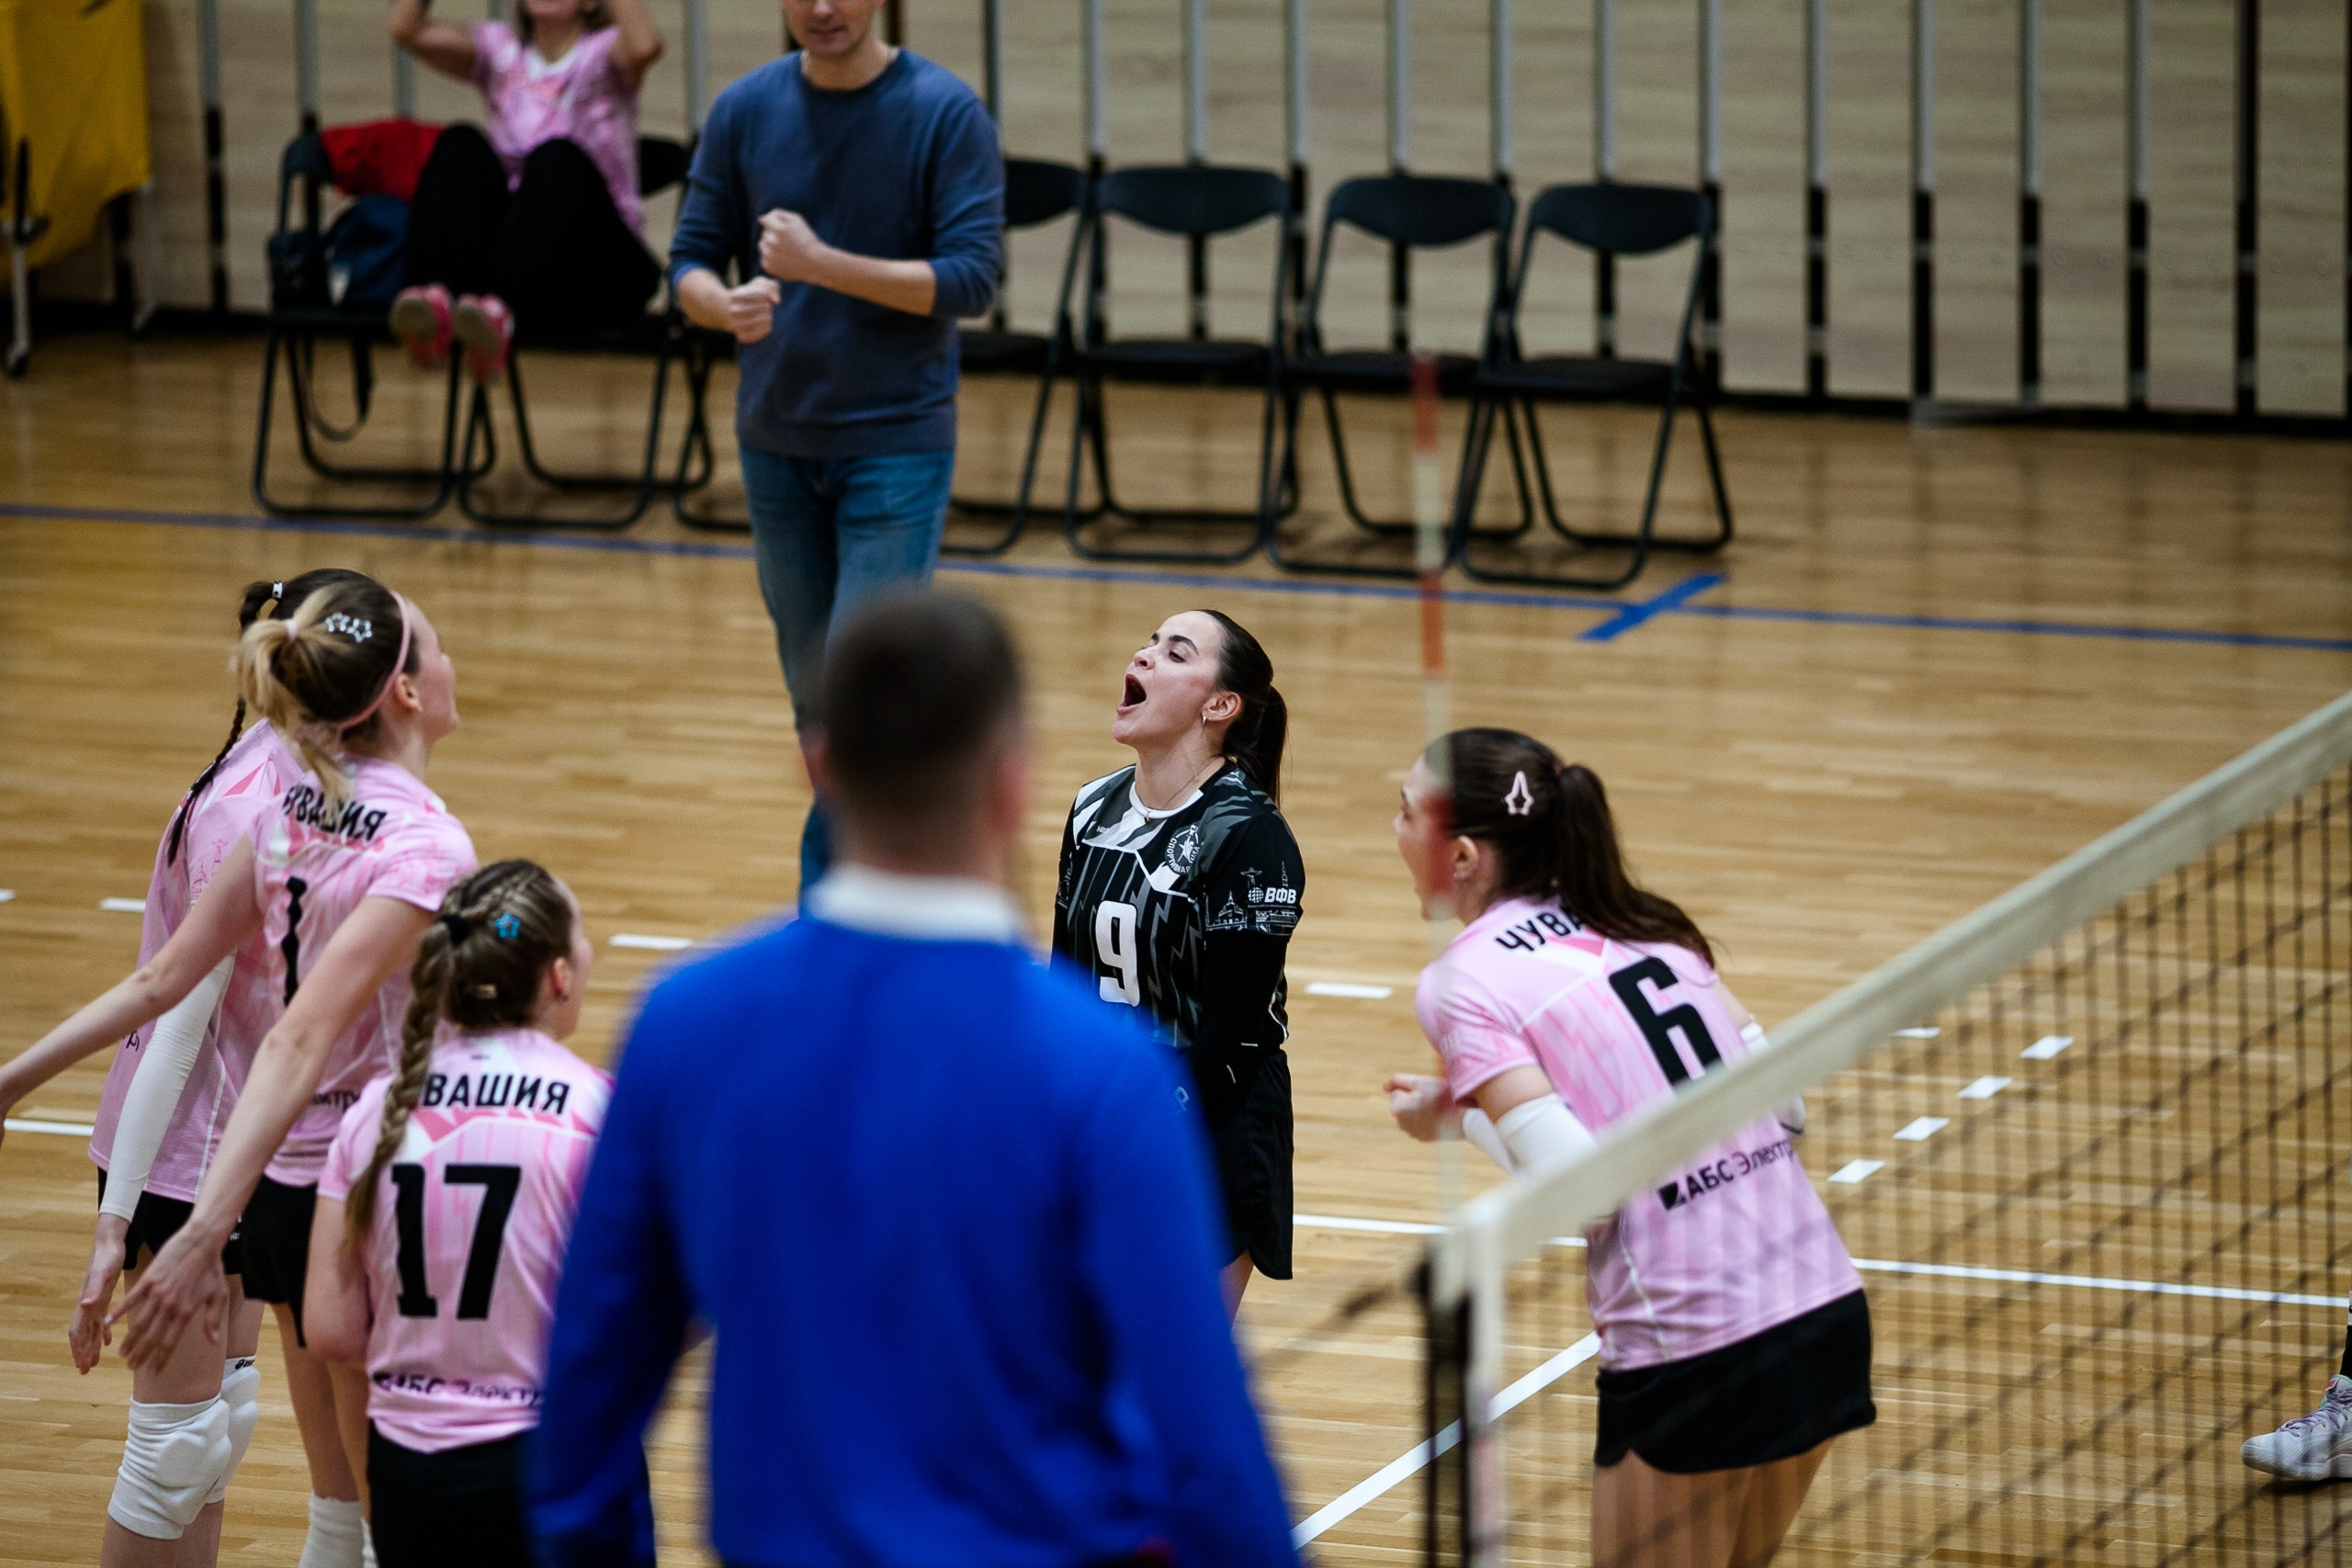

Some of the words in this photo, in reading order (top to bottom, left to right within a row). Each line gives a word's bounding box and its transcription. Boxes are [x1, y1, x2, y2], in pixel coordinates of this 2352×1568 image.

[280, 875, 308, 1008] 1
[1264, 887, 1296, 904] ВФВ
[1095, 900, 1140, 1007] 9
[1608, 956, 1724, 1086] 6
[423, 1073, 571, 1115] ВАШИЯ
[1685, 1157, 1735, 1201] АБС
[391, 1162, 521, 1321] 17
